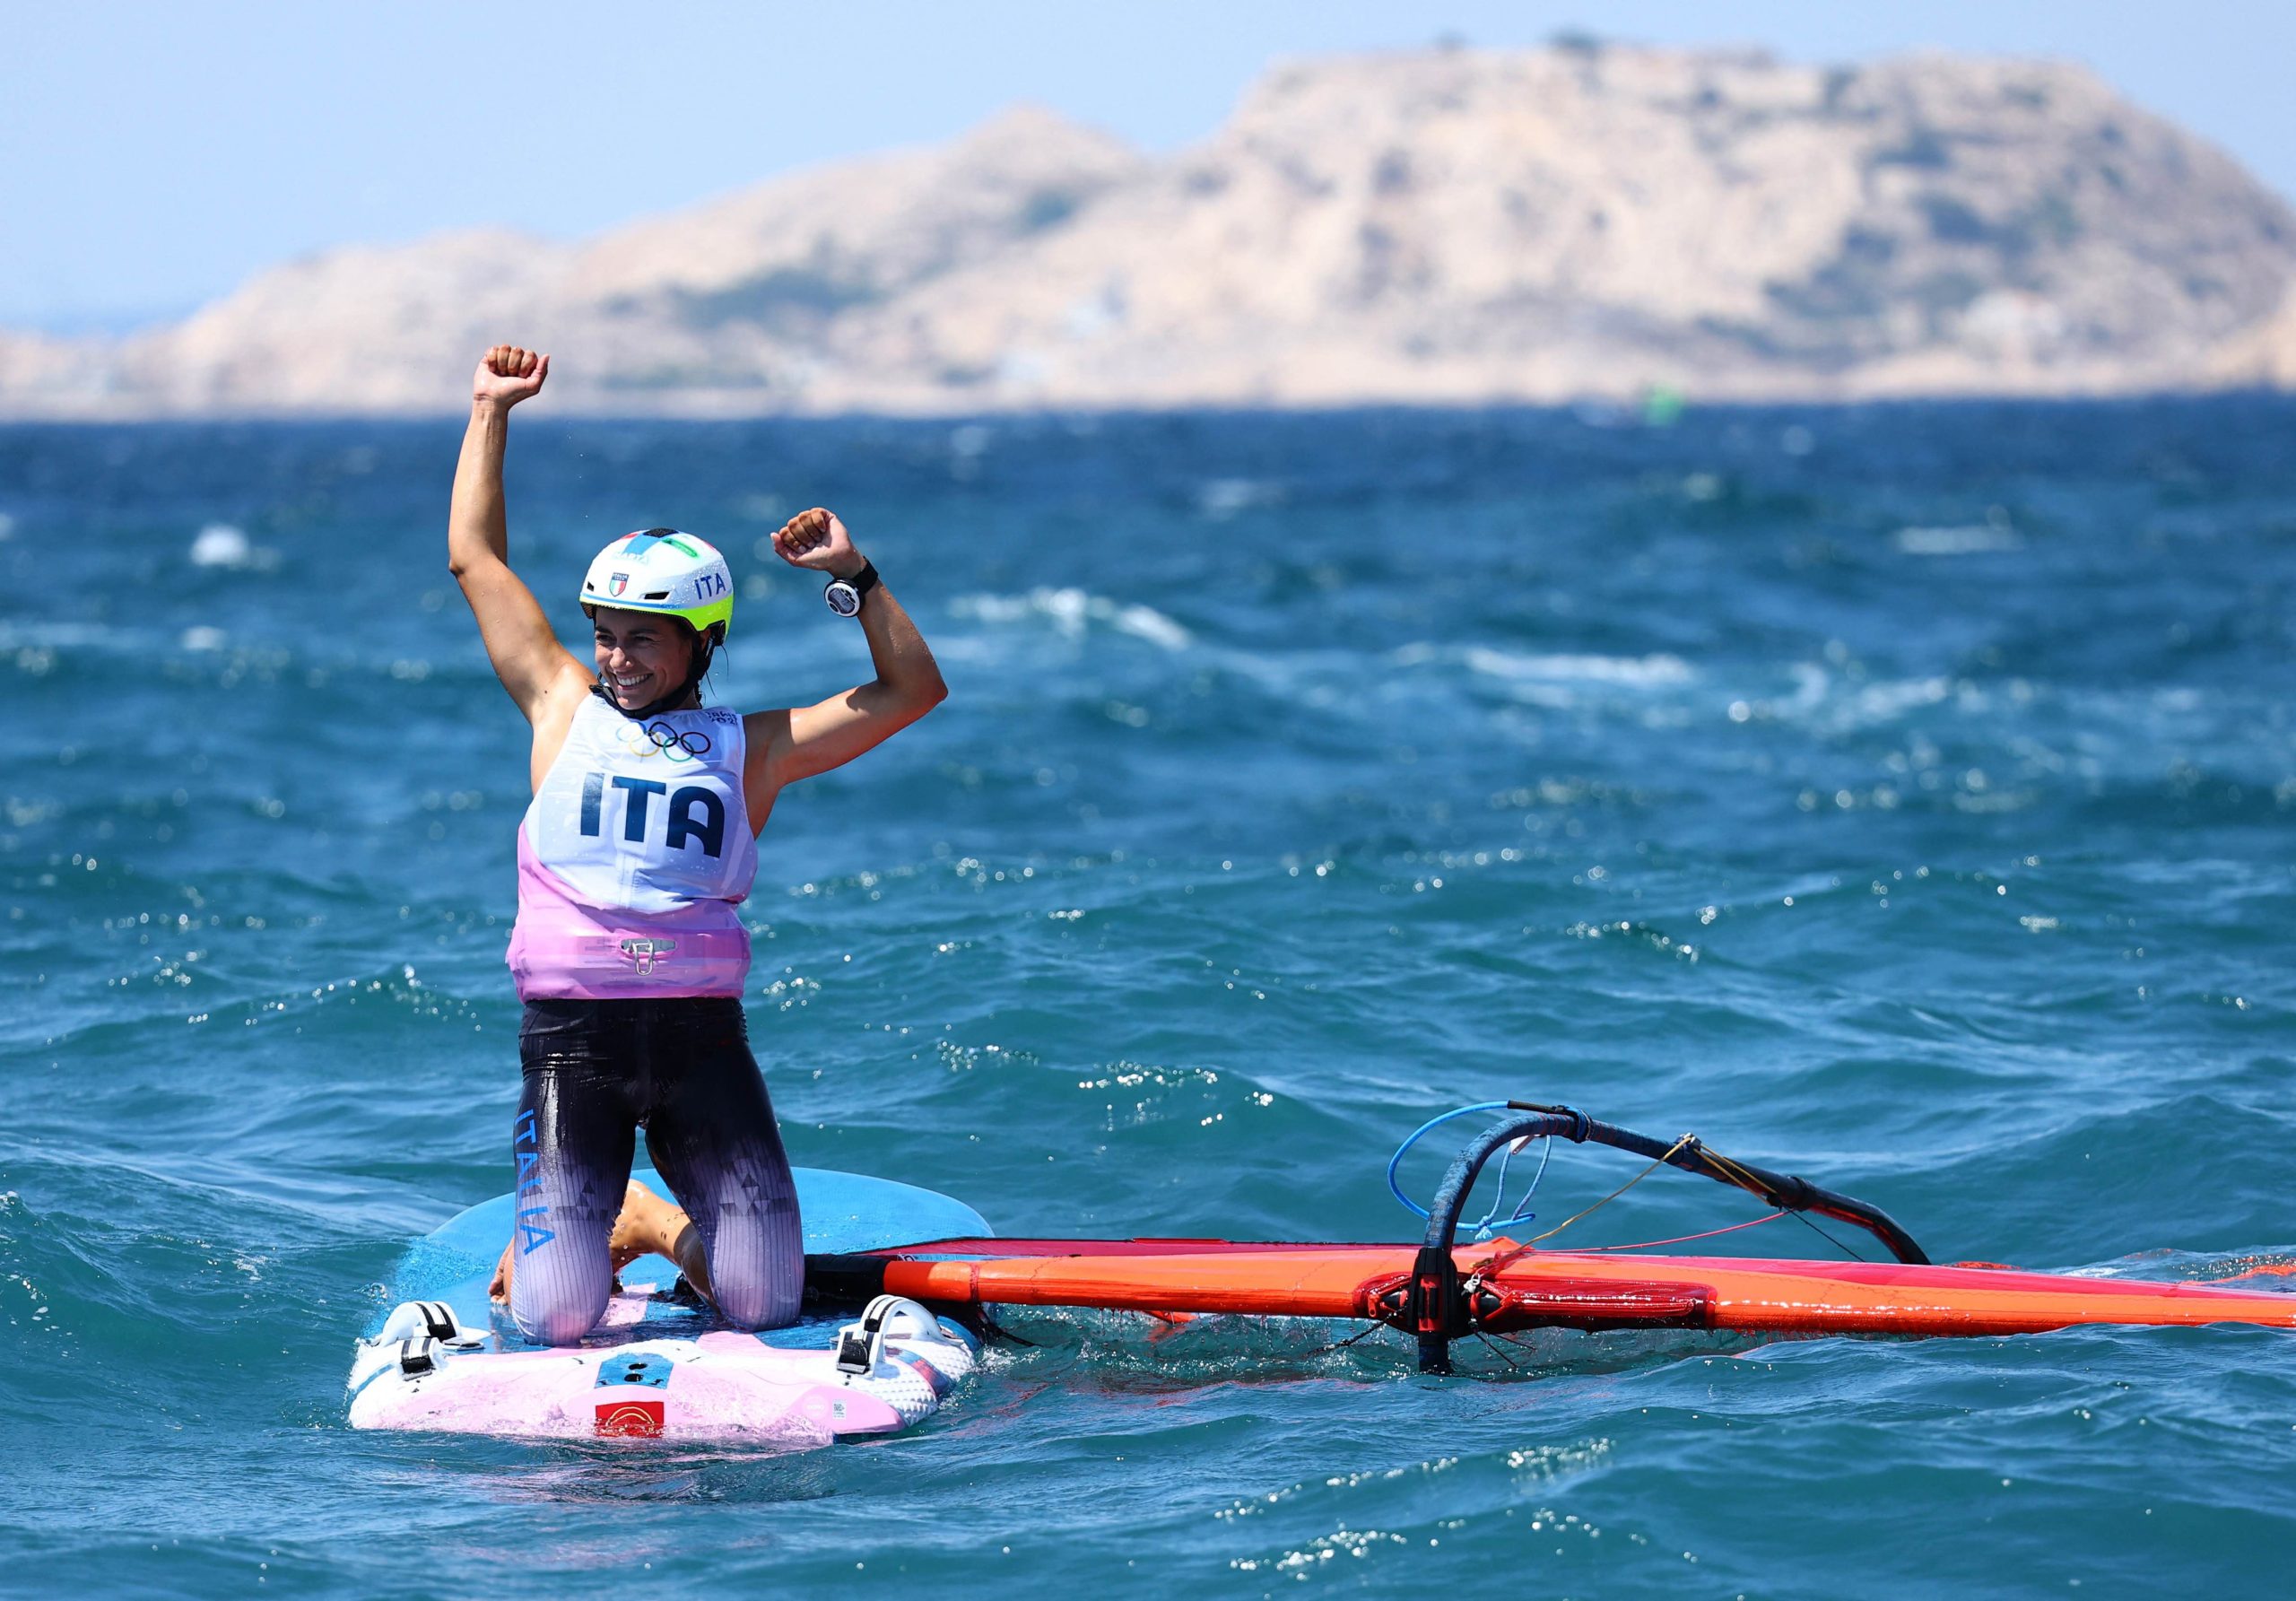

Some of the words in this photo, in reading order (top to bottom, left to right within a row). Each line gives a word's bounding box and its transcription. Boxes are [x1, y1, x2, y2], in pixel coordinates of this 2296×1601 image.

[694, 572, 726, 600] ITA
[580, 772, 726, 859] ITA
[514, 1109, 555, 1256] ITALIA
